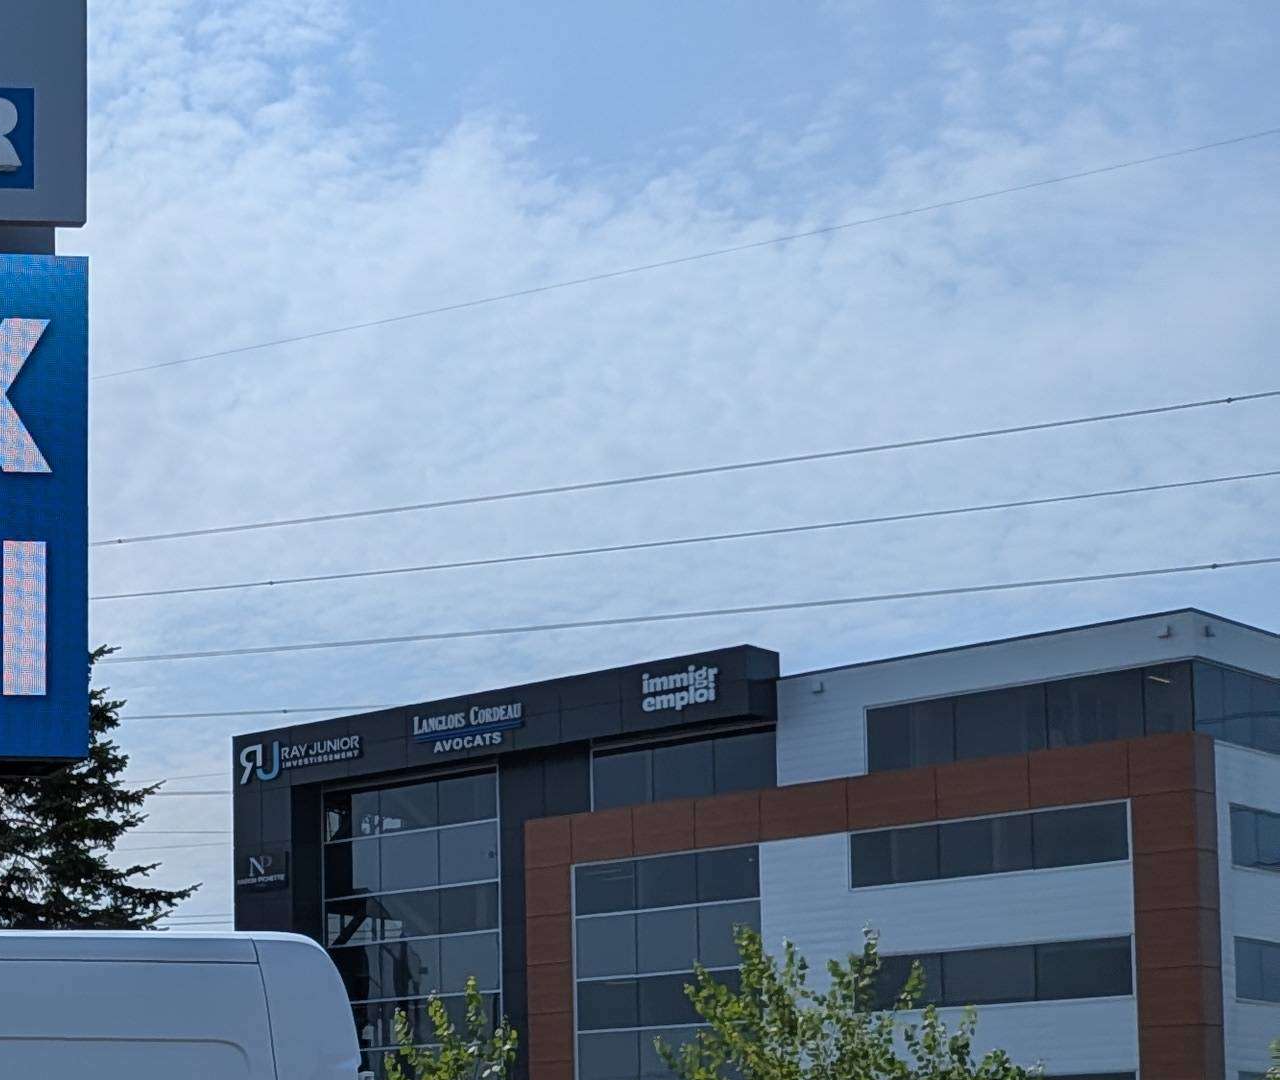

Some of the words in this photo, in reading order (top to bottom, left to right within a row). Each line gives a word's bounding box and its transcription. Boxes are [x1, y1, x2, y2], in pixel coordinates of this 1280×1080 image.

[641, 664, 719, 695] immigr
[641, 681, 717, 713] emploi
[413, 711, 467, 736] LANGLOIS
[469, 702, 523, 726] CORDEAU
[280, 743, 308, 761] RAY
[308, 735, 361, 756] JUNIOR
[432, 731, 503, 754] AVOCATS
